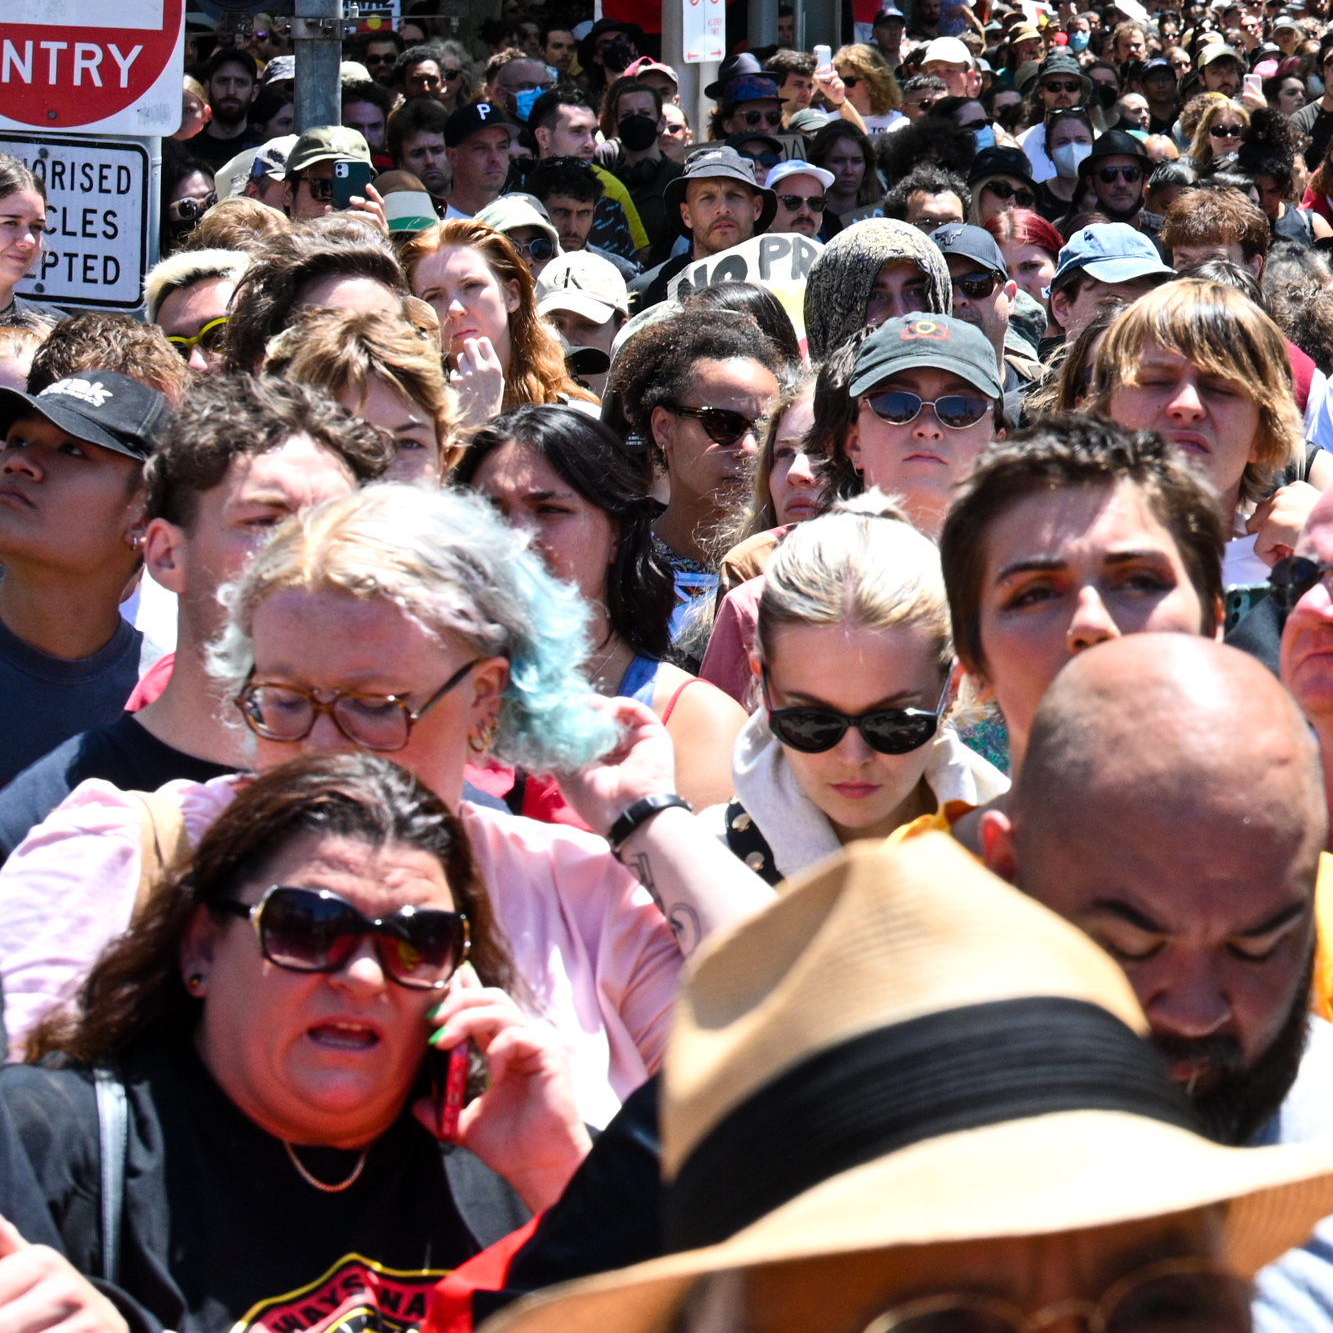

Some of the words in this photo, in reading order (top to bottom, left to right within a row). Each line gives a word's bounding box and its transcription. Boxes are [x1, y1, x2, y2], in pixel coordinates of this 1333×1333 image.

[0, 39, 143, 88] NTRY
[476, 103, 491, 120] P
[677, 254, 748, 300] NO
[758, 236, 820, 282] PR
[378, 1287, 427, 1319] WA
